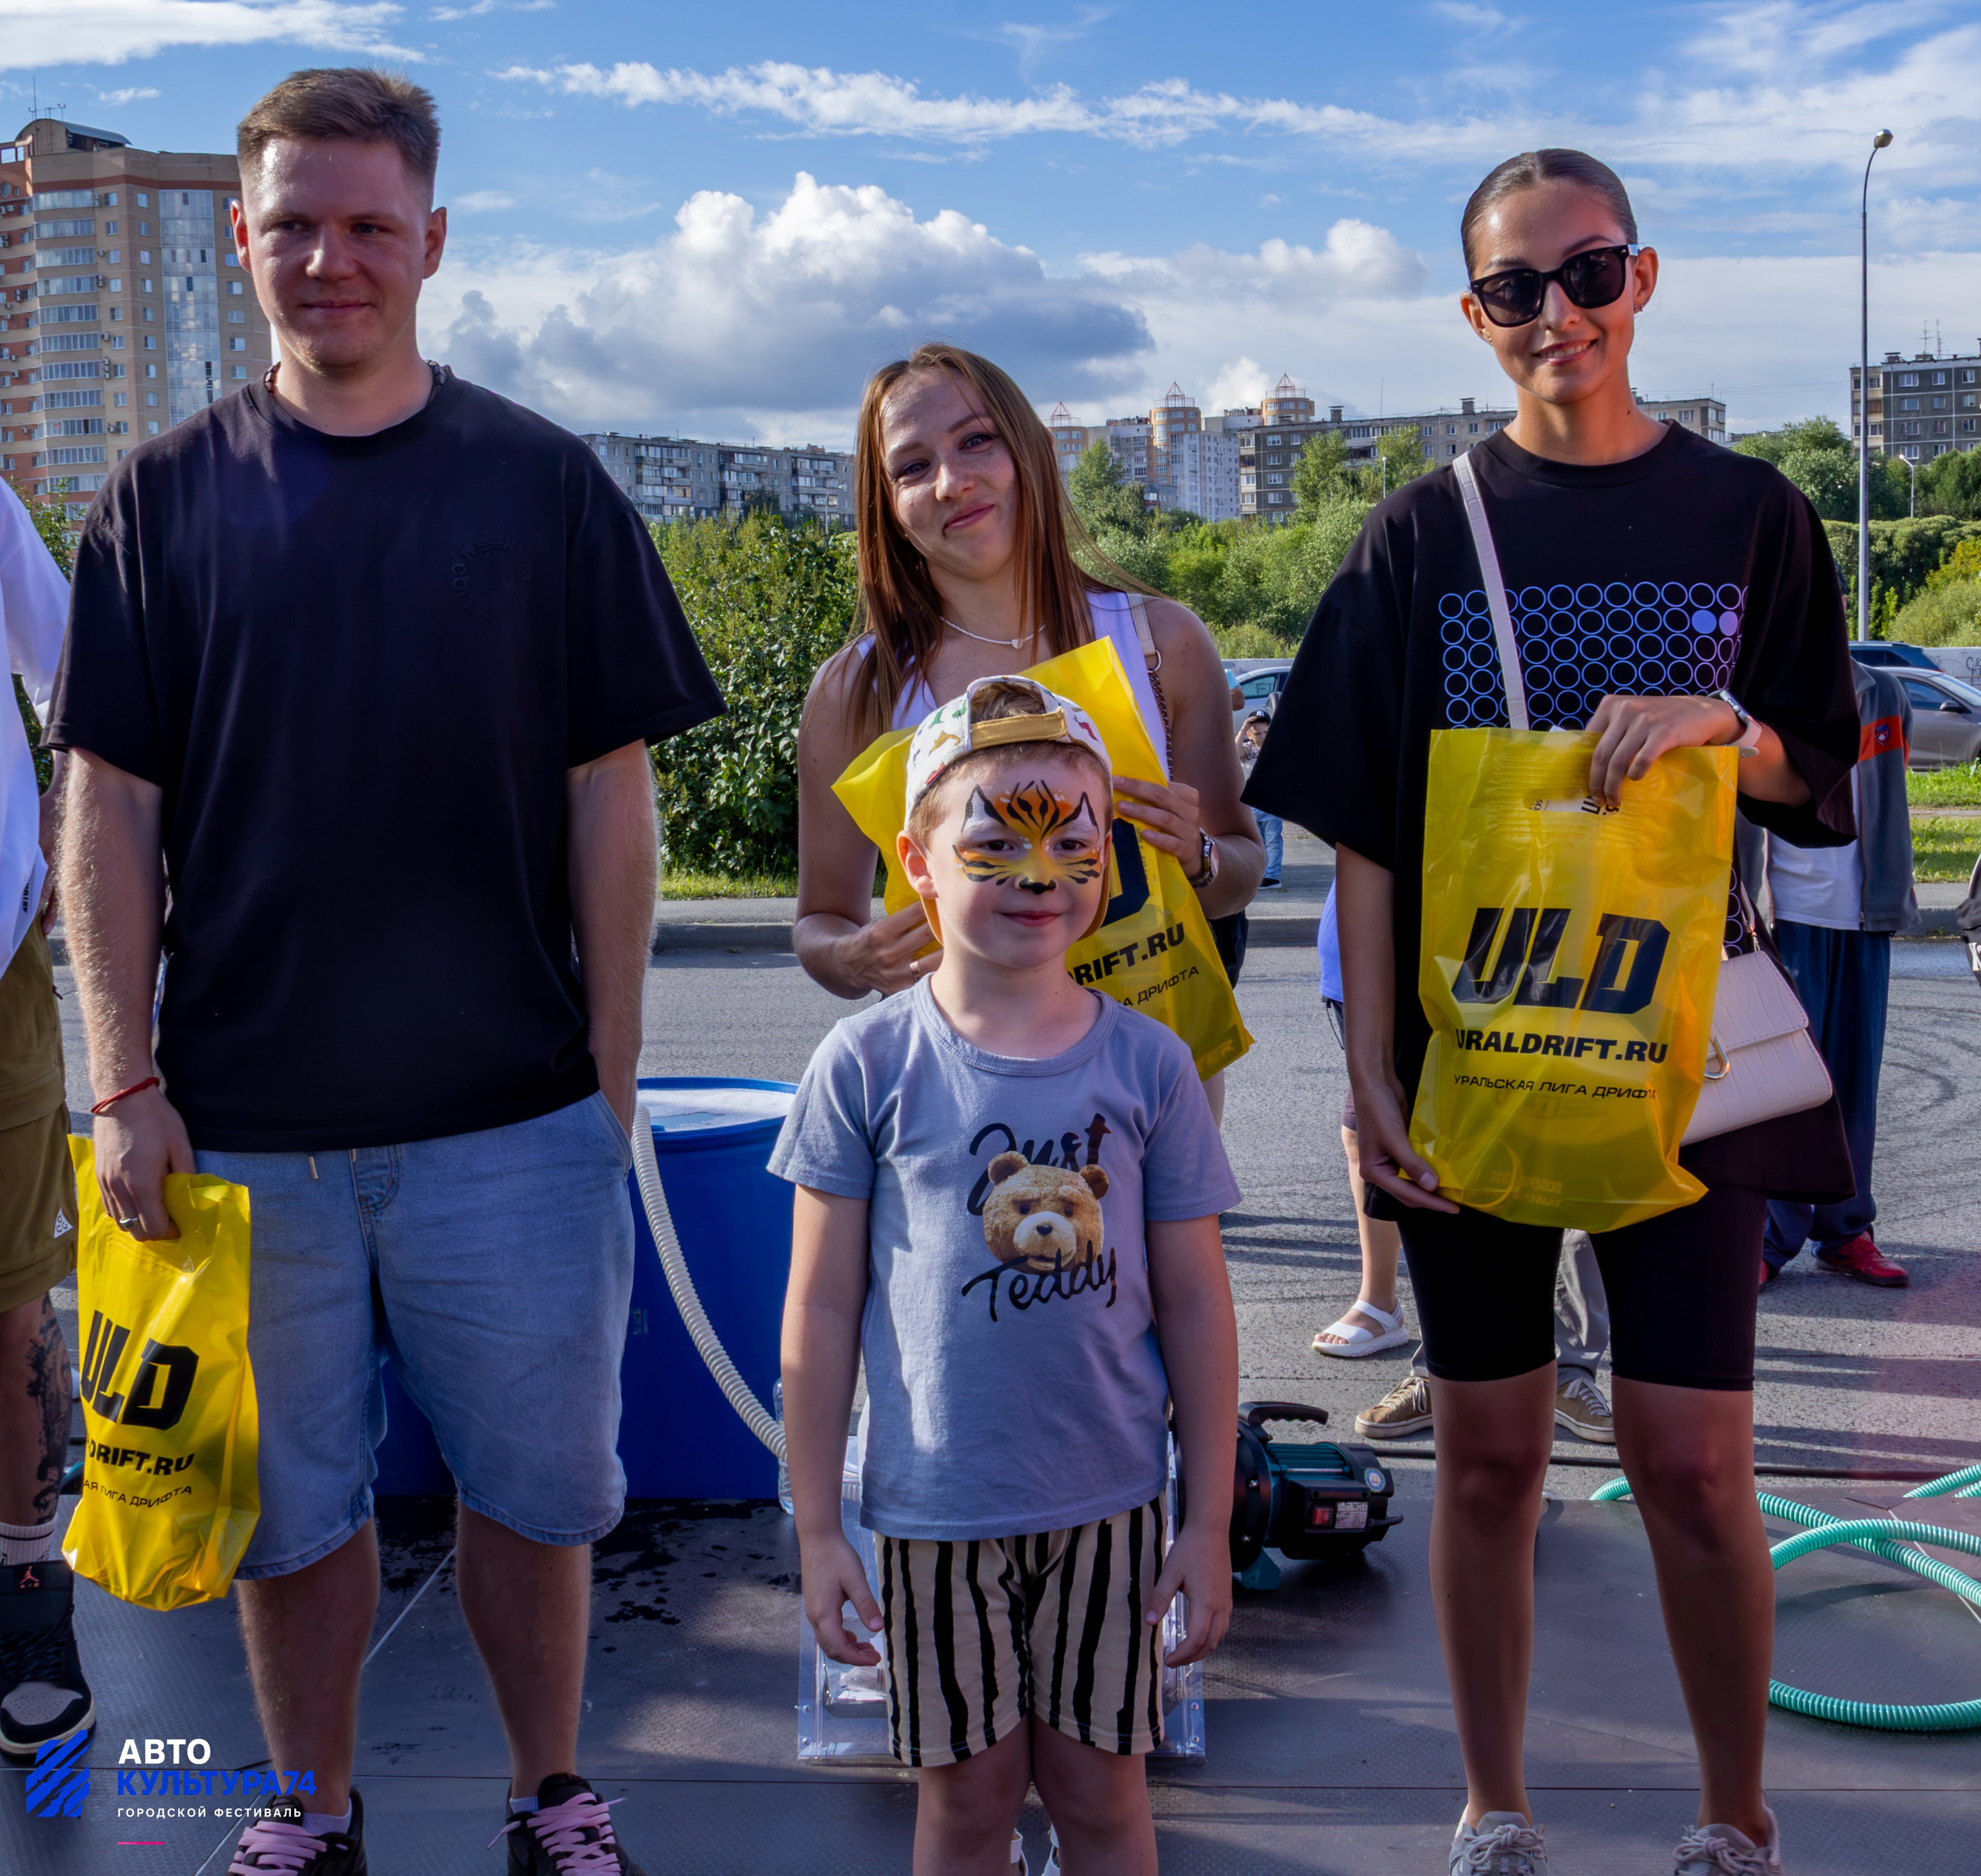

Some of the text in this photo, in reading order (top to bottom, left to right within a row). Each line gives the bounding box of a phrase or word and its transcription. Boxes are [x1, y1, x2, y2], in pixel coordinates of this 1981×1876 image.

[1068, 922, 1186, 986] RIFT.RU
[1452, 907, 1671, 1015] ULD
[1137, 966, 1199, 1005] ДРИФТА
[1456, 1029, 1668, 1064] URALDRIFT.RU
[1454, 1074, 1535, 1091] УРАЛЬСКАЯ
[1538, 1082, 1587, 1096] ЛИГА
[961, 1239, 1117, 1323] Teddy
[80, 1309, 200, 1431] ULD
[87, 1438, 195, 1476] DRIFT.RU
[129, 1485, 193, 1508] ДРИФТА
